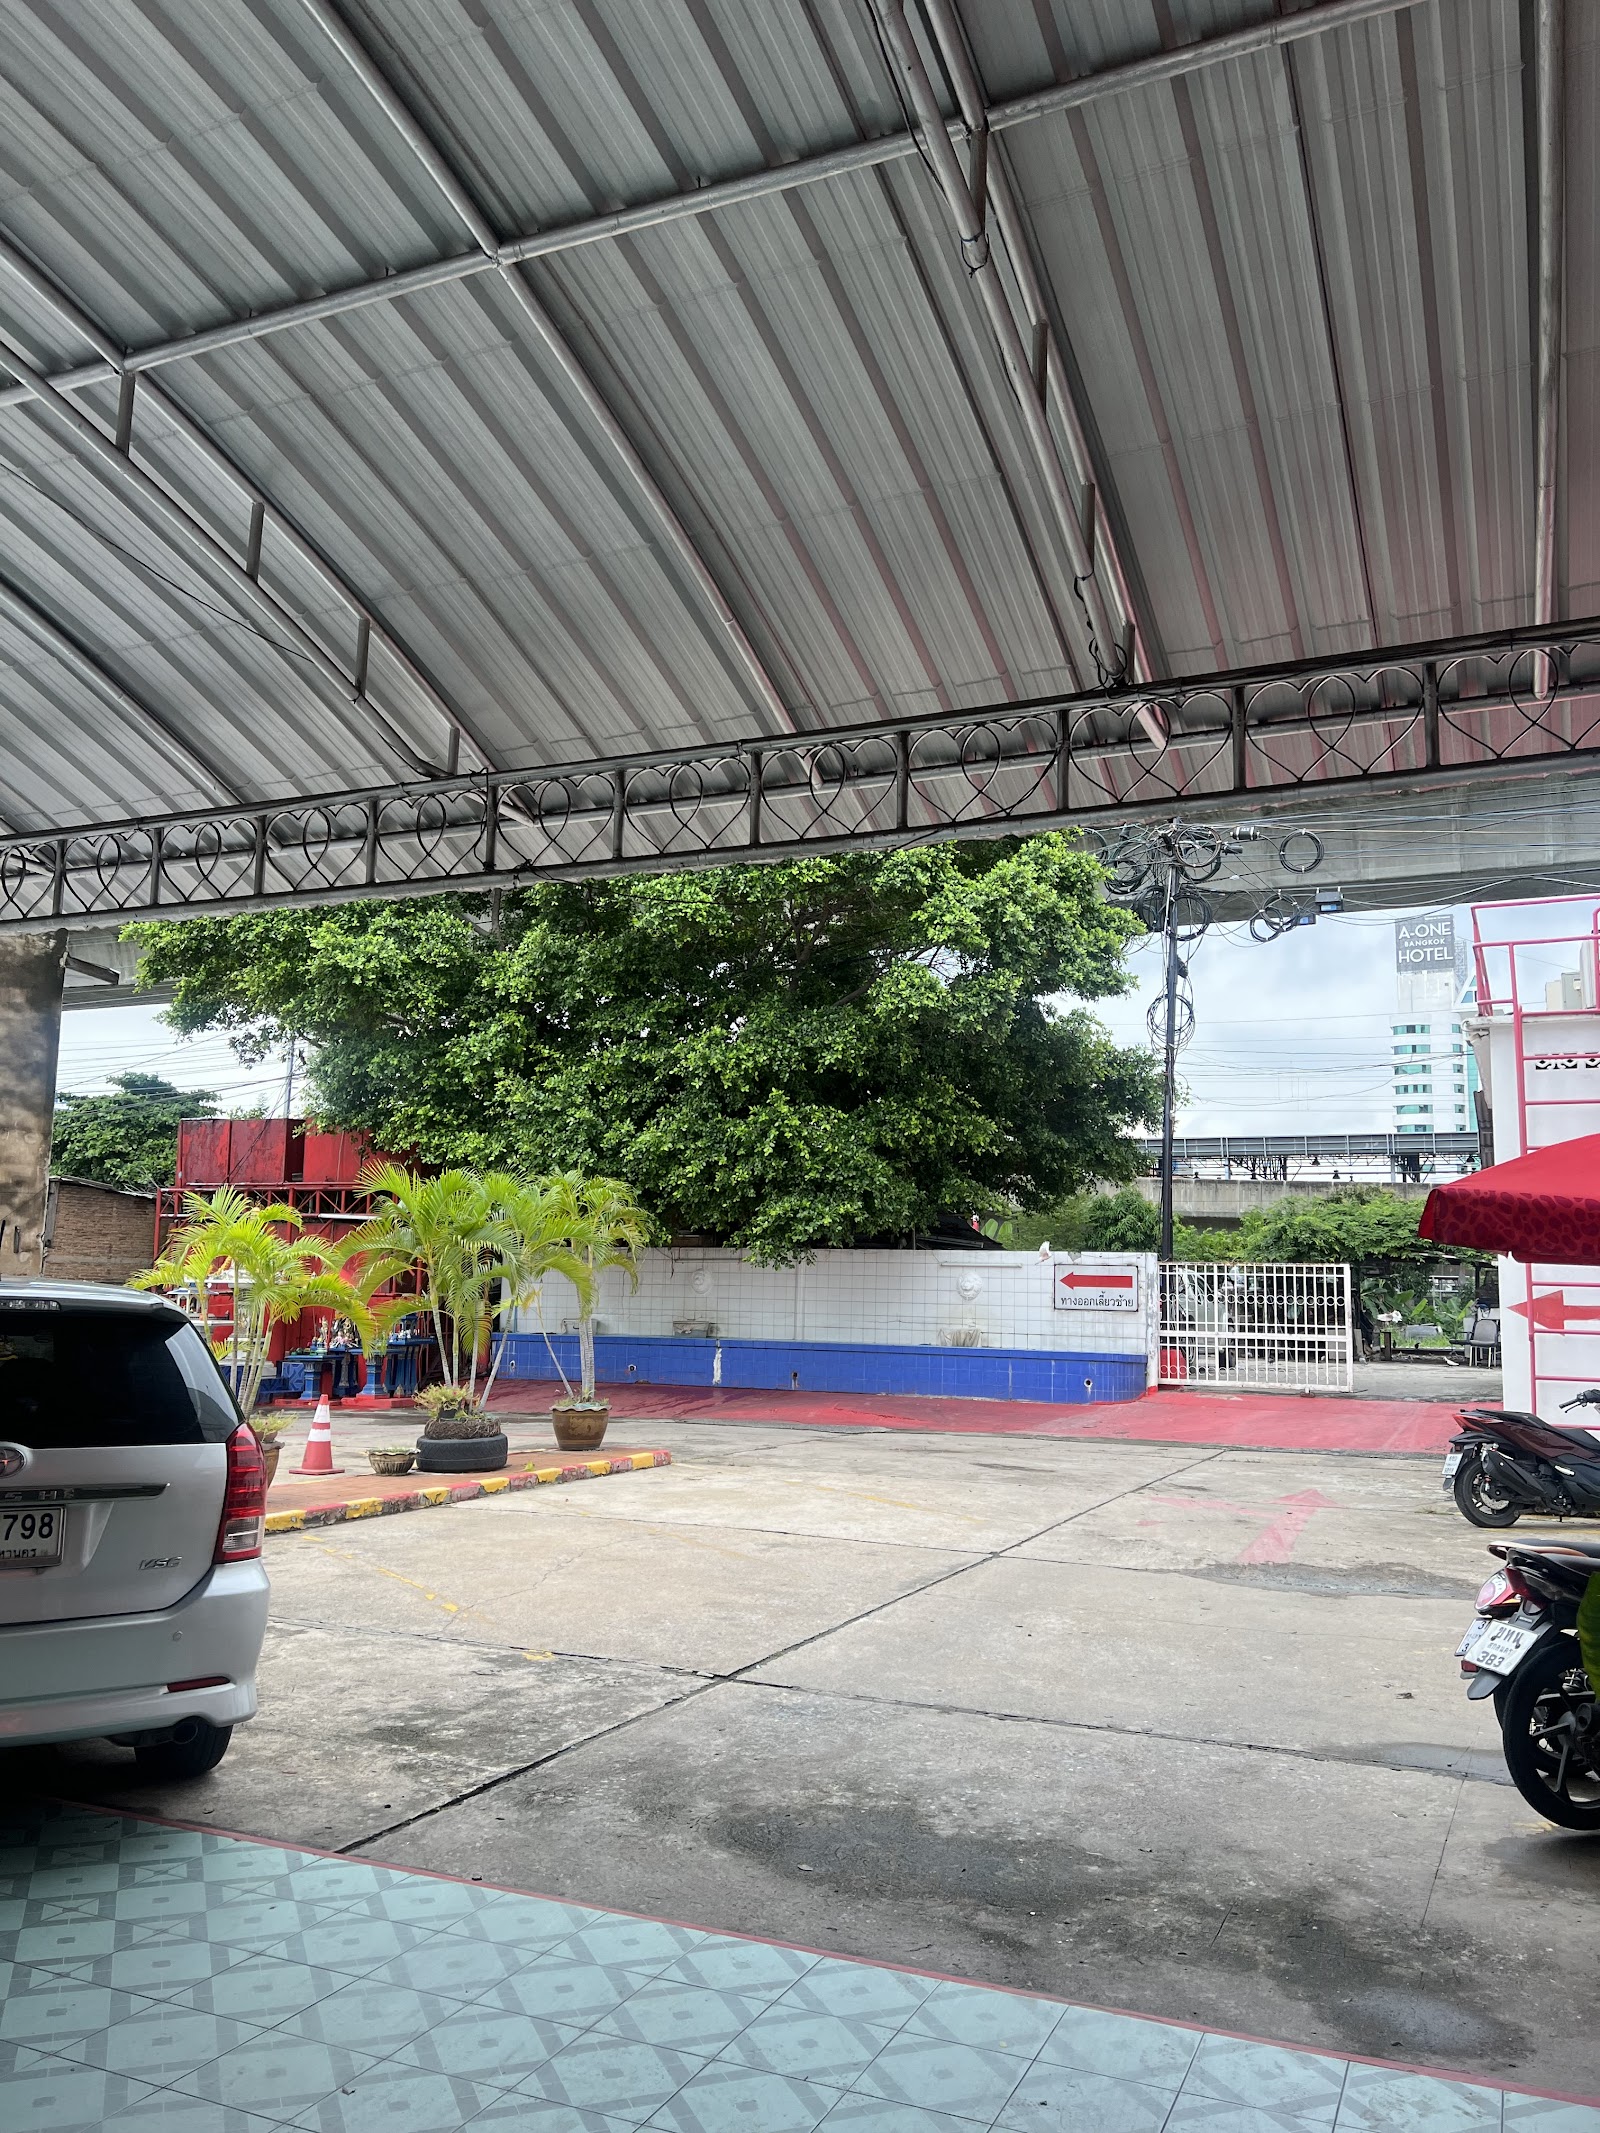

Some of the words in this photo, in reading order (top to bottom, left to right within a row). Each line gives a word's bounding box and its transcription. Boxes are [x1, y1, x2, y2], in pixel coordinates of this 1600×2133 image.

[1398, 921, 1452, 940] A-ONE
[1404, 938, 1446, 948] BANGKOK
[1398, 946, 1454, 964] HOTEL
[1060, 1290, 1134, 1307] ทางออกเลี้ยวซ้าย
[3, 1512, 54, 1541] 798
[1476, 1650, 1505, 1668] 383
